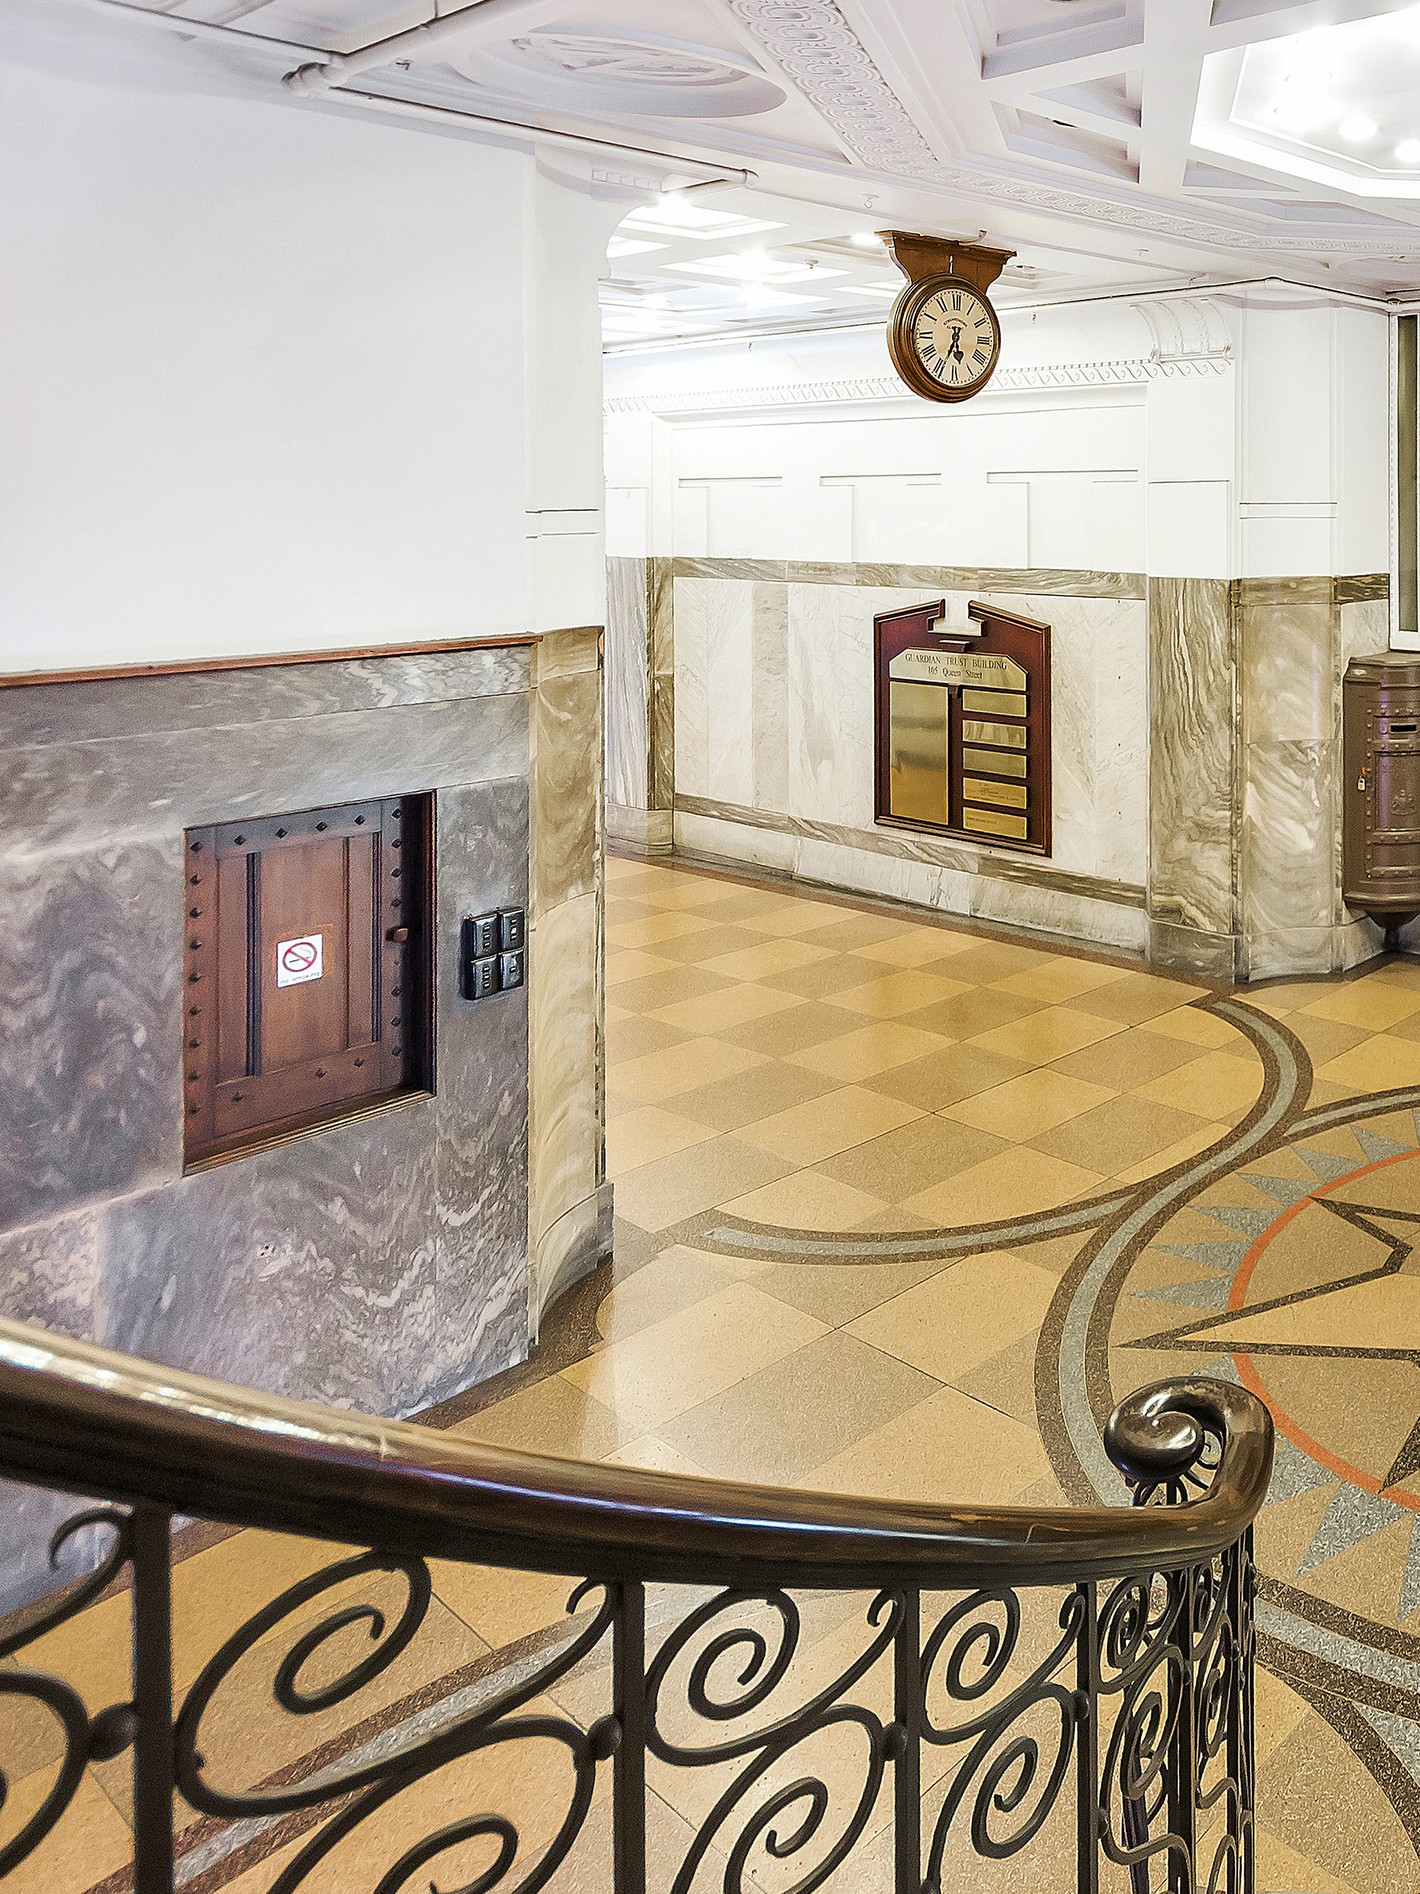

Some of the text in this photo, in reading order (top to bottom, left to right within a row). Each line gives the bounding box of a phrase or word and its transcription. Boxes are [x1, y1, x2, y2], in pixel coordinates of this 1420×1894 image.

[905, 653, 1007, 670] GUARDIAN TRUST BUILDING
[942, 667, 961, 677] Queen
[965, 670, 983, 679] Street
